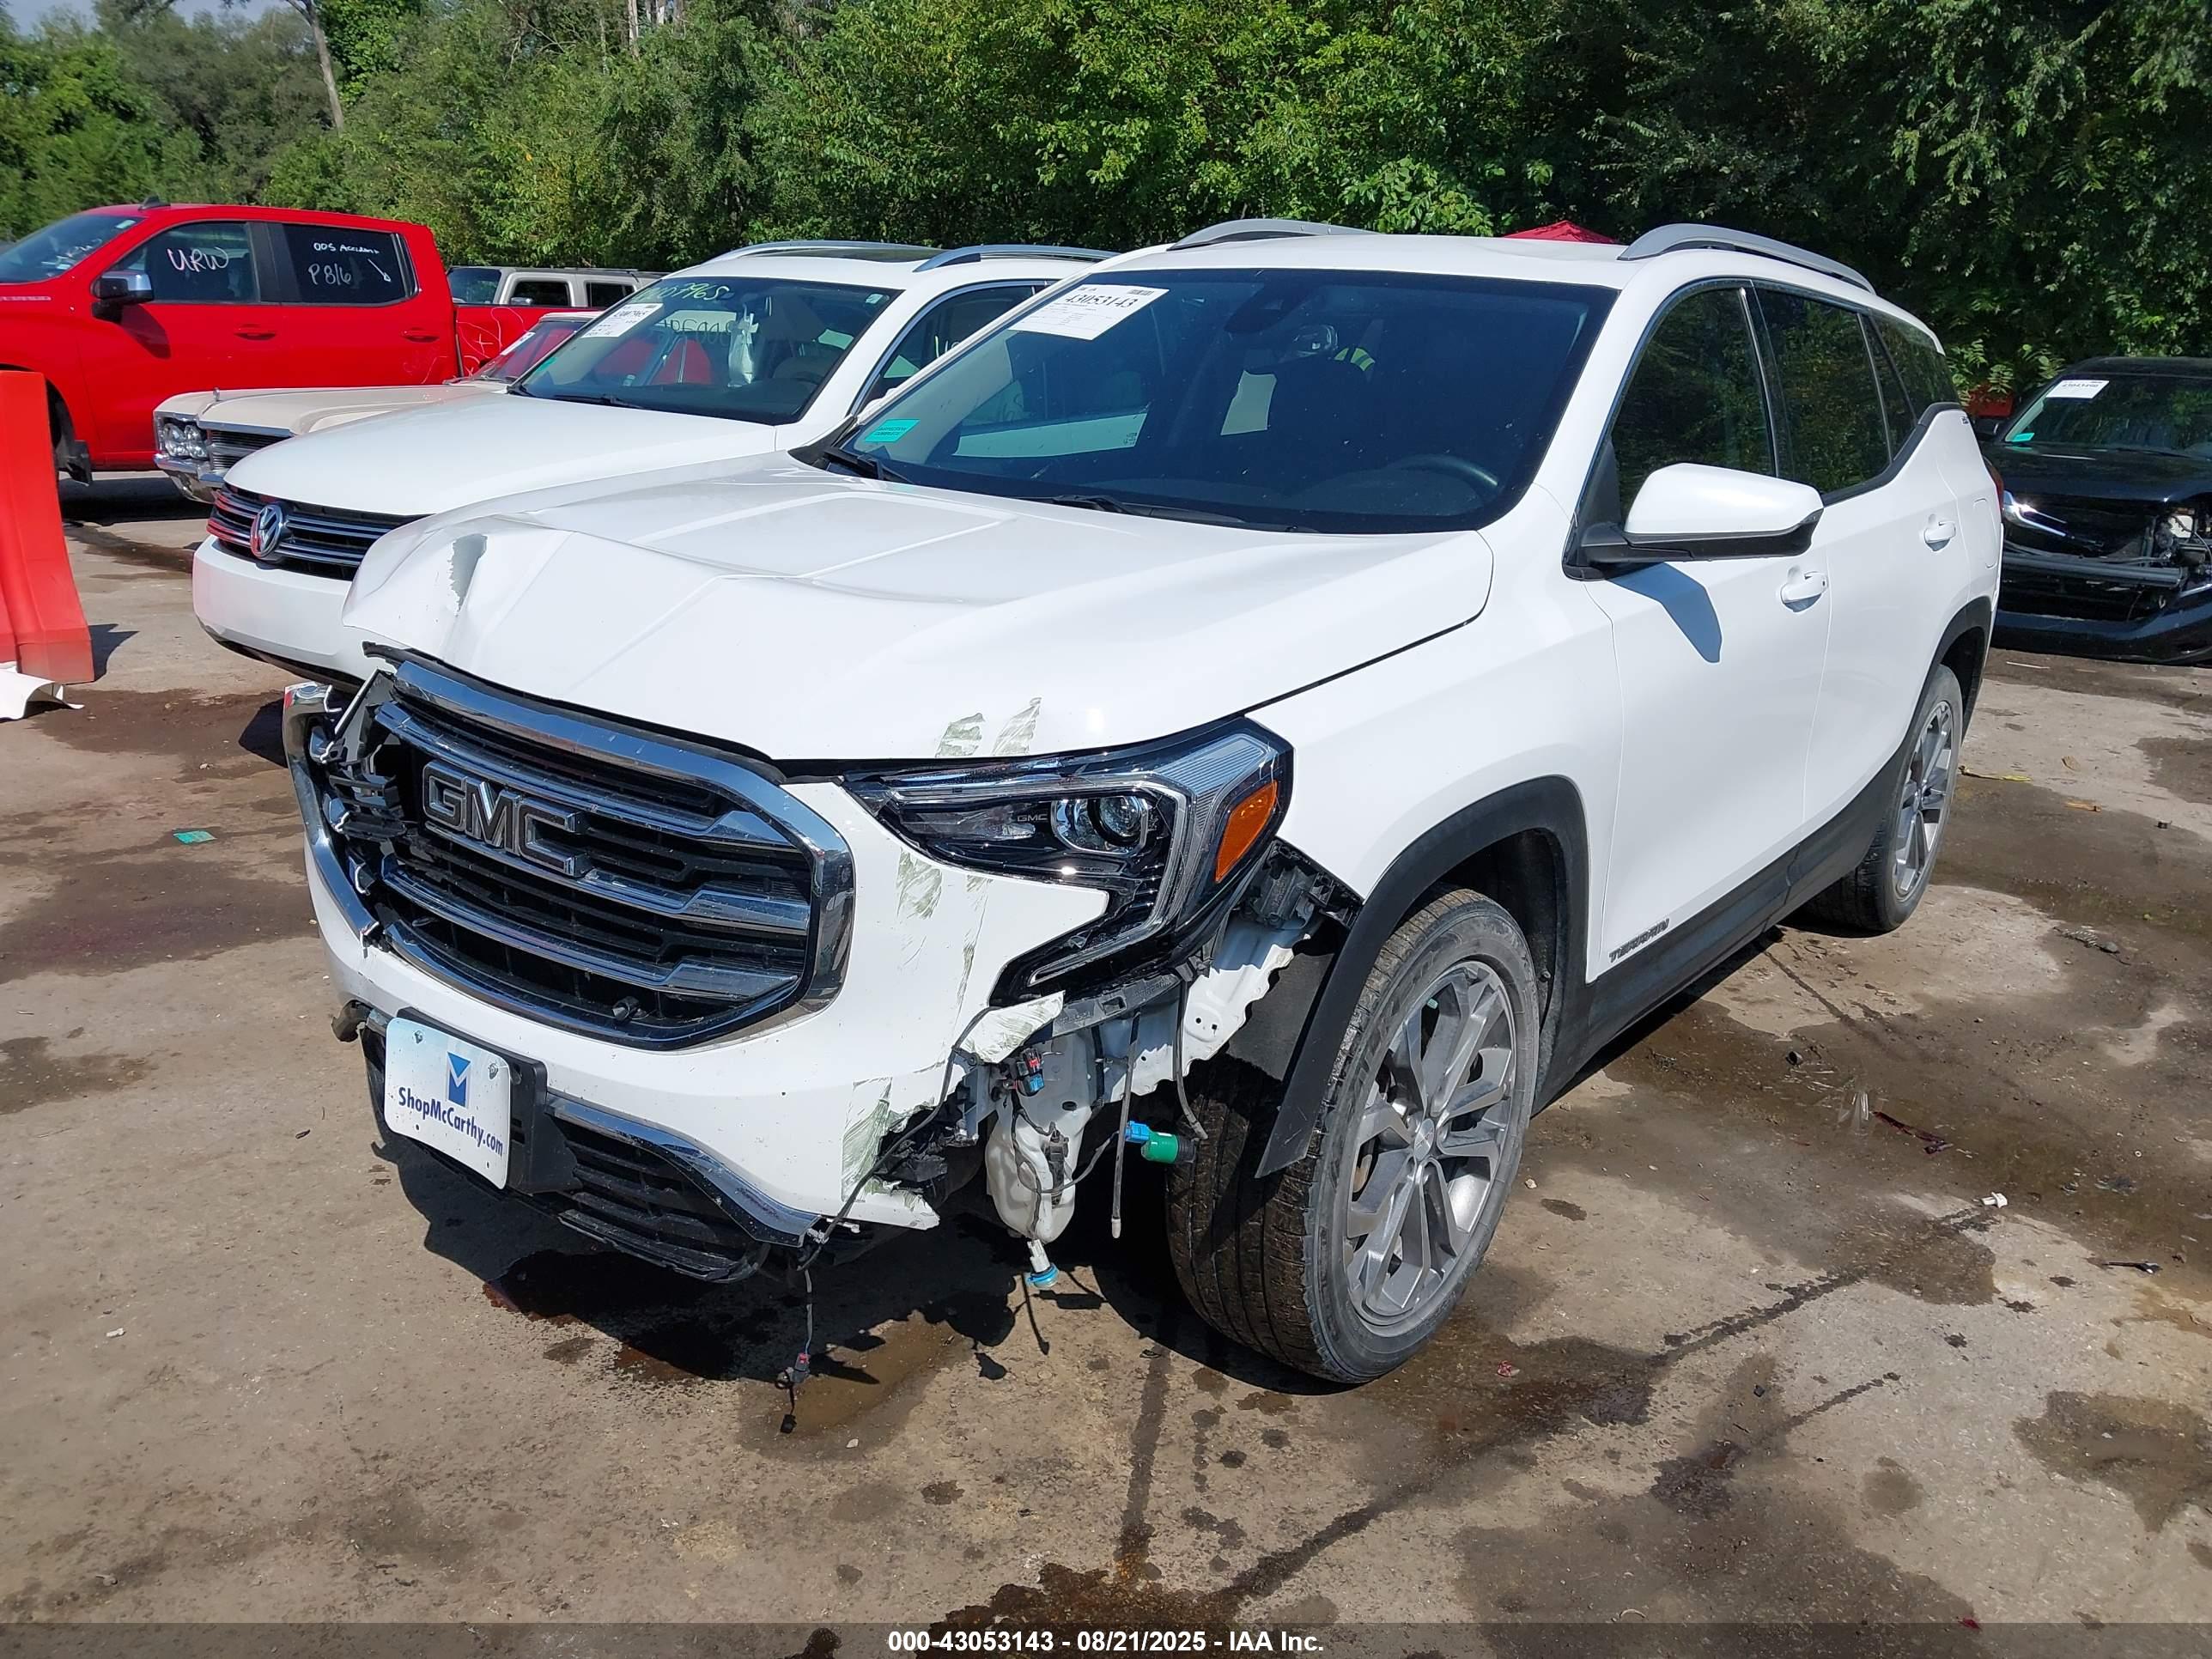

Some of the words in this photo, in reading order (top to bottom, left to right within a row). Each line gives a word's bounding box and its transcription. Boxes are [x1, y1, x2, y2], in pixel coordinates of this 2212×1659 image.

[1065, 294, 1139, 308] 43053143
[422, 761, 590, 878] GMC
[1017, 813, 1048, 823] GMC
[398, 1086, 504, 1158] ShopMcCarthy.com
